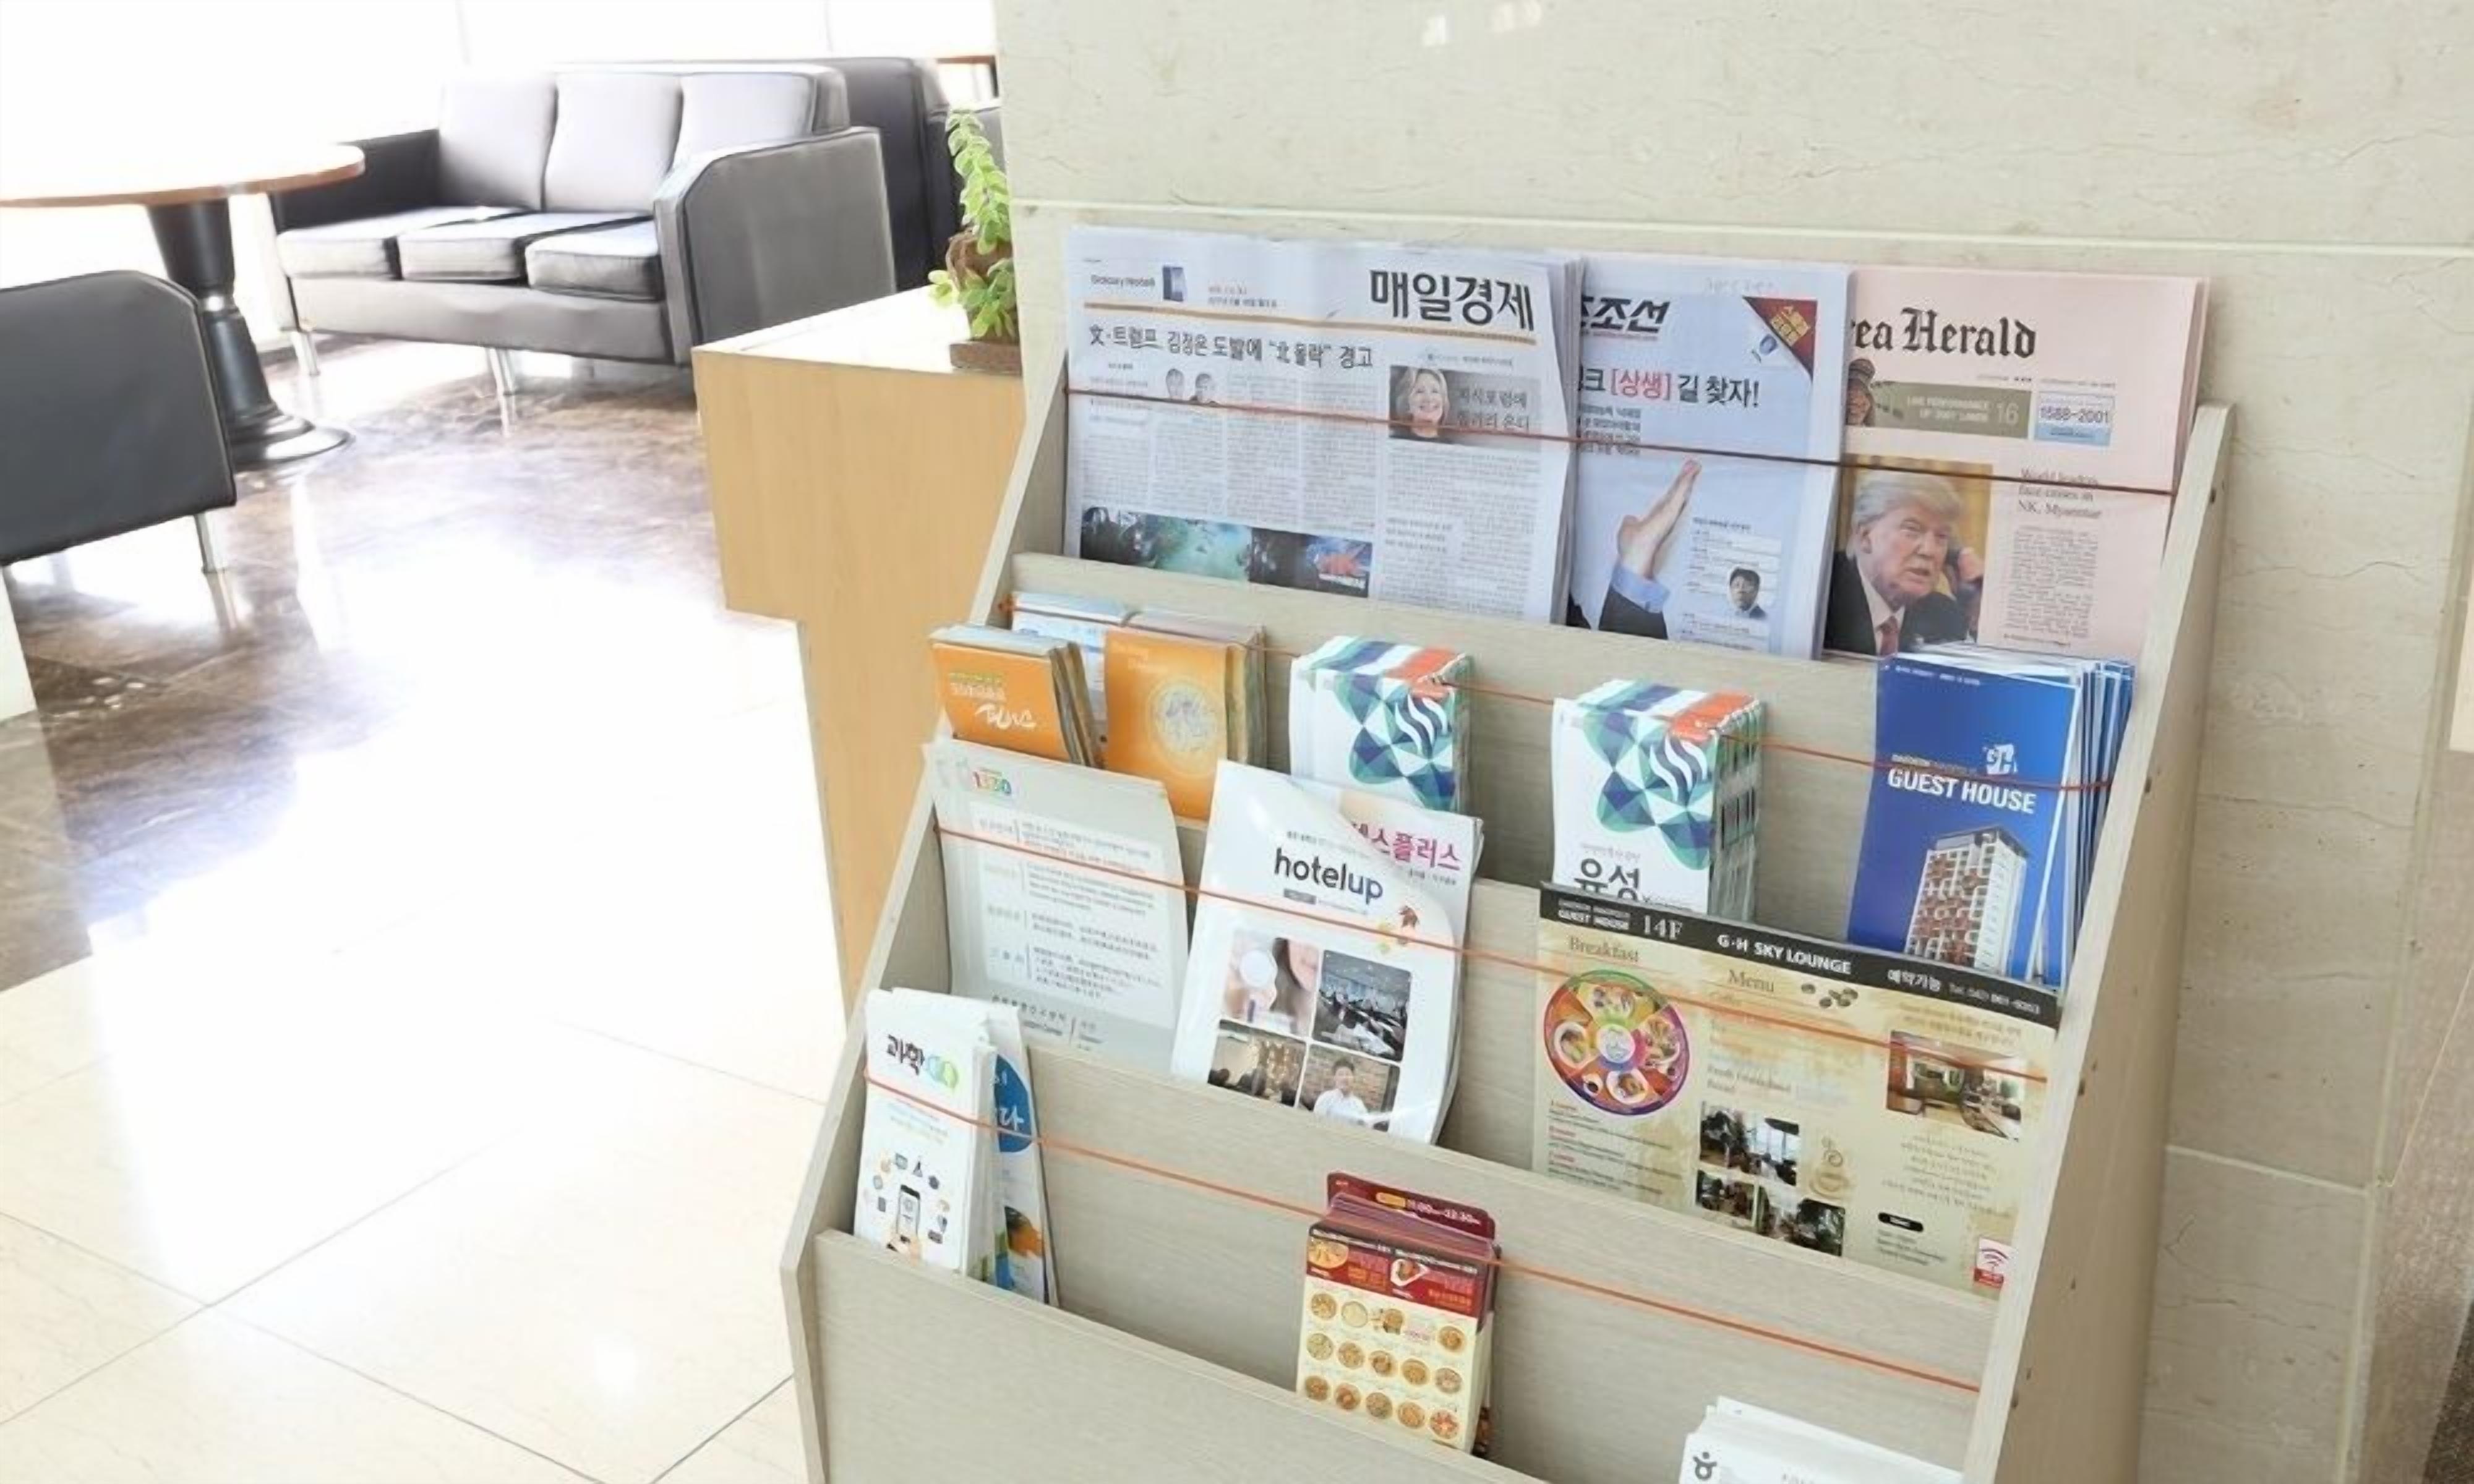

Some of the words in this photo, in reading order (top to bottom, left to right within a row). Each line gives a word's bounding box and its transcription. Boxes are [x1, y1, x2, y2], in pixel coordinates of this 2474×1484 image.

[1369, 269, 1534, 331] 매일경제
[1168, 331, 1208, 356] 김정은
[1213, 336, 1263, 361] 도발에
[1339, 345, 1374, 369] 경고
[1901, 306, 2036, 359] Herald
[1677, 374, 1699, 404] 길
[1705, 374, 1760, 409] 찾자!
[1996, 403, 2019, 425] 16
[1887, 768, 1958, 799] GUEST
[1962, 781, 2037, 814] HOUSE
[1274, 846, 1384, 904] hotelup
[1575, 857, 1641, 902] 유성
[1643, 914, 1684, 940] 14F
[1568, 934, 1640, 963] Breakfast
[1754, 942, 1784, 960] SKY
[1786, 948, 1852, 974] LOUNGE
[1727, 969, 1775, 993] Menu
[886, 1034, 925, 1076] 과학
